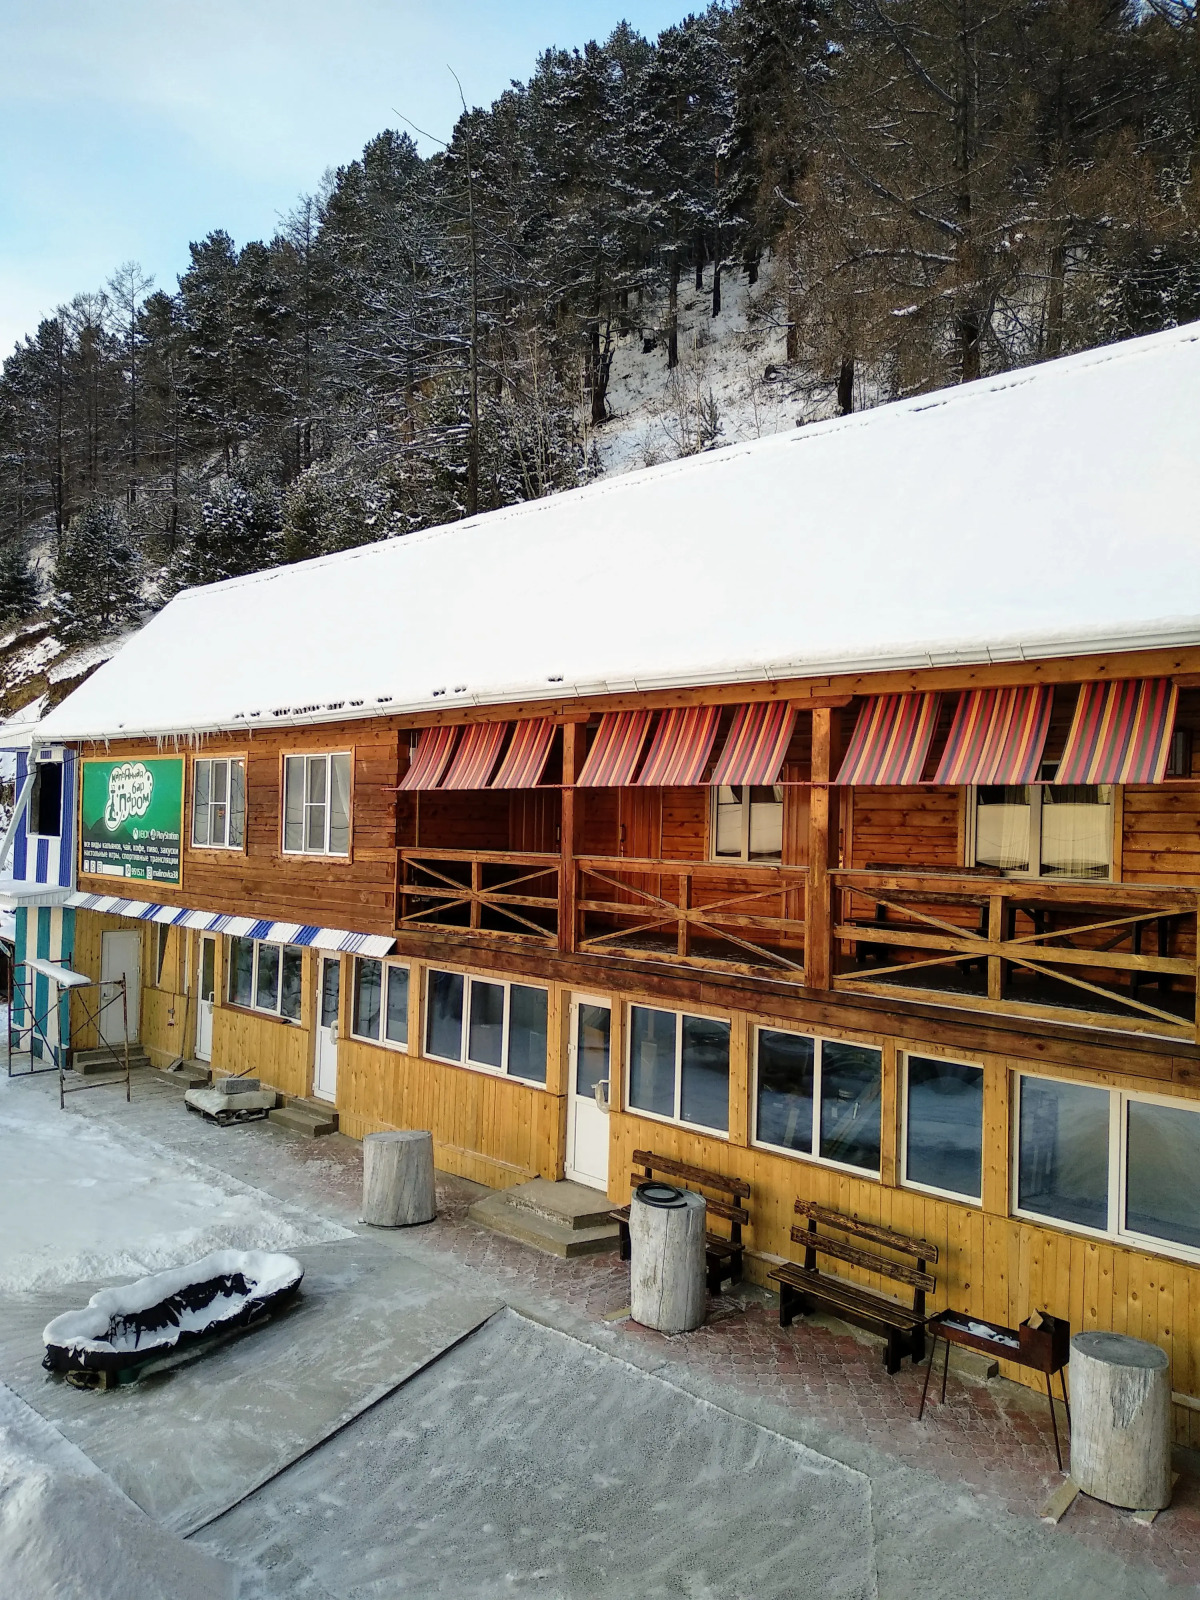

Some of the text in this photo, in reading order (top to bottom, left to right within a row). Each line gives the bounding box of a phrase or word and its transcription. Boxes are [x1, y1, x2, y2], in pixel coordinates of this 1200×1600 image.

[132, 781, 145, 794] бар
[156, 831, 179, 842] PlayStation
[160, 847, 178, 856] закуски
[122, 853, 148, 862] спортивные
[150, 856, 178, 865] трансляции
